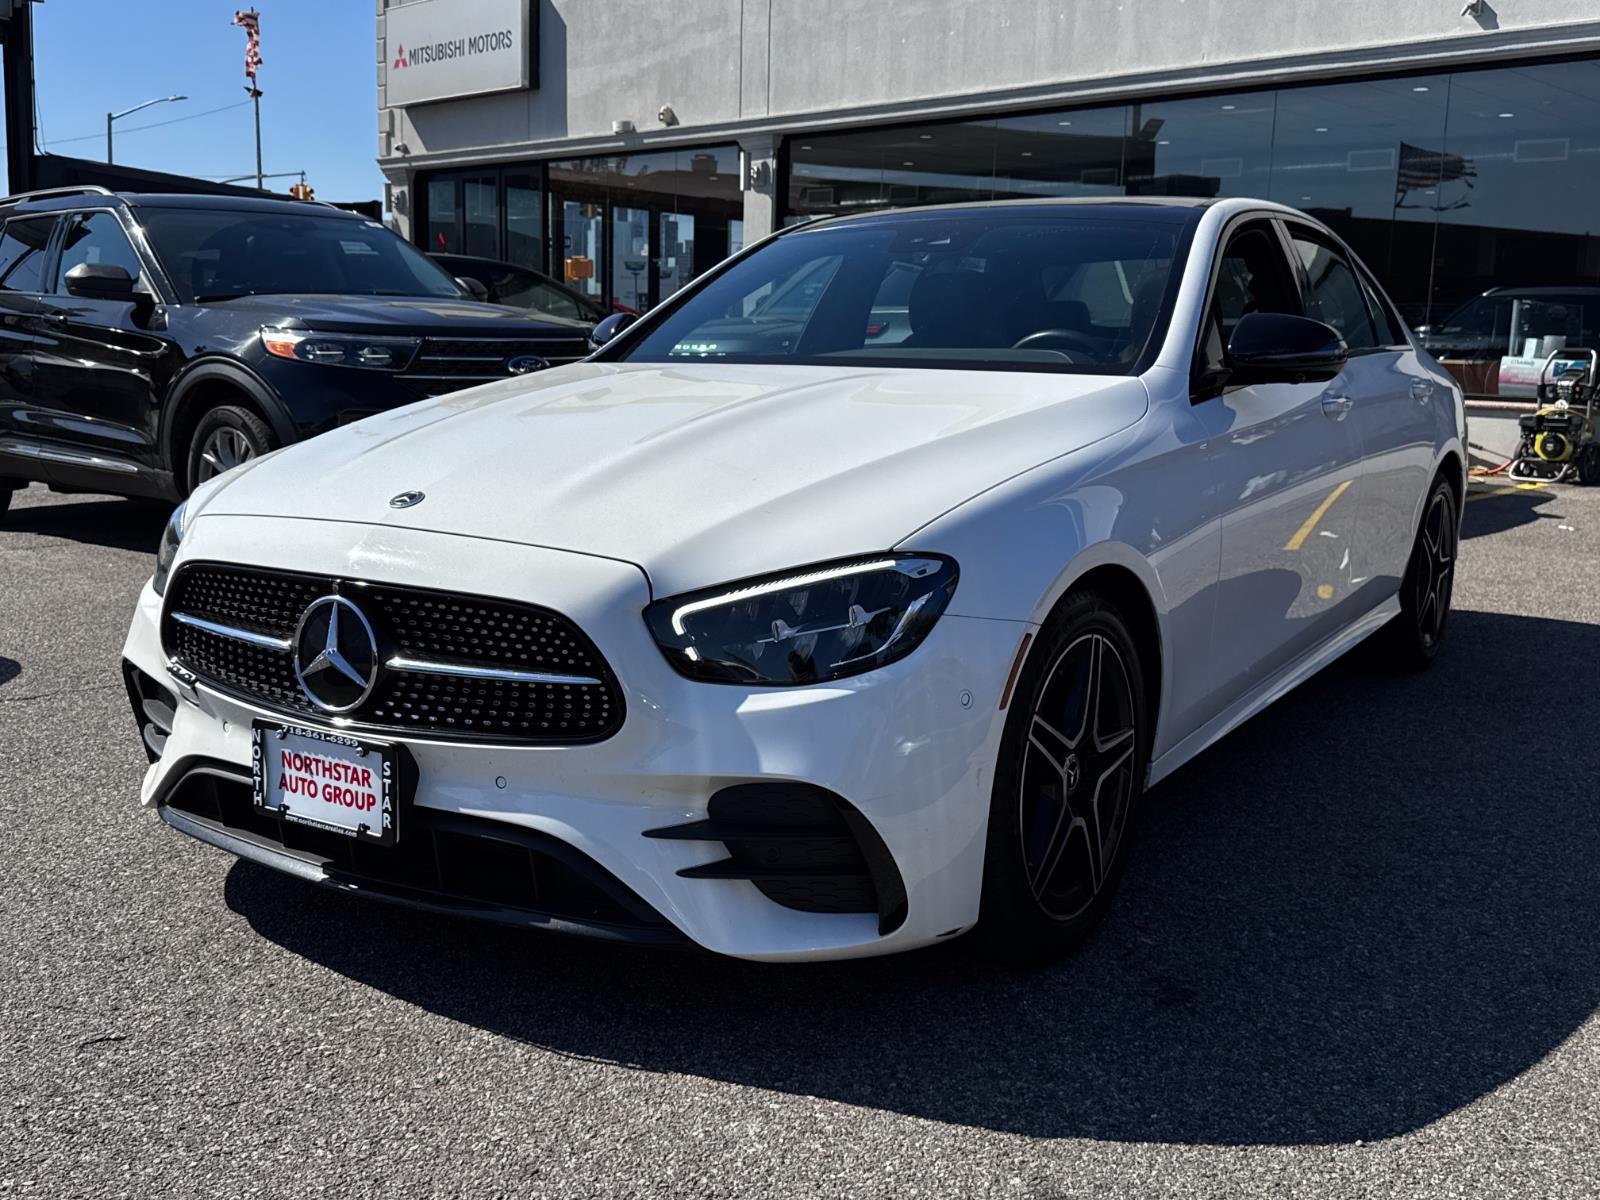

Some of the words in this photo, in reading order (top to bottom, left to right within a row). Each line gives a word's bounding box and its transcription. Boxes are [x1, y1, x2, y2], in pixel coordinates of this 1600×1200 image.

[409, 38, 465, 67] MITSUBISHI
[468, 29, 513, 56] MOTORS
[282, 725, 359, 747] 718-361-6299
[252, 728, 263, 806] NORTH
[281, 750, 373, 789] NORTHSTAR
[278, 773, 318, 799] AUTO
[322, 784, 377, 812] GROUP
[382, 761, 392, 829] STAR
